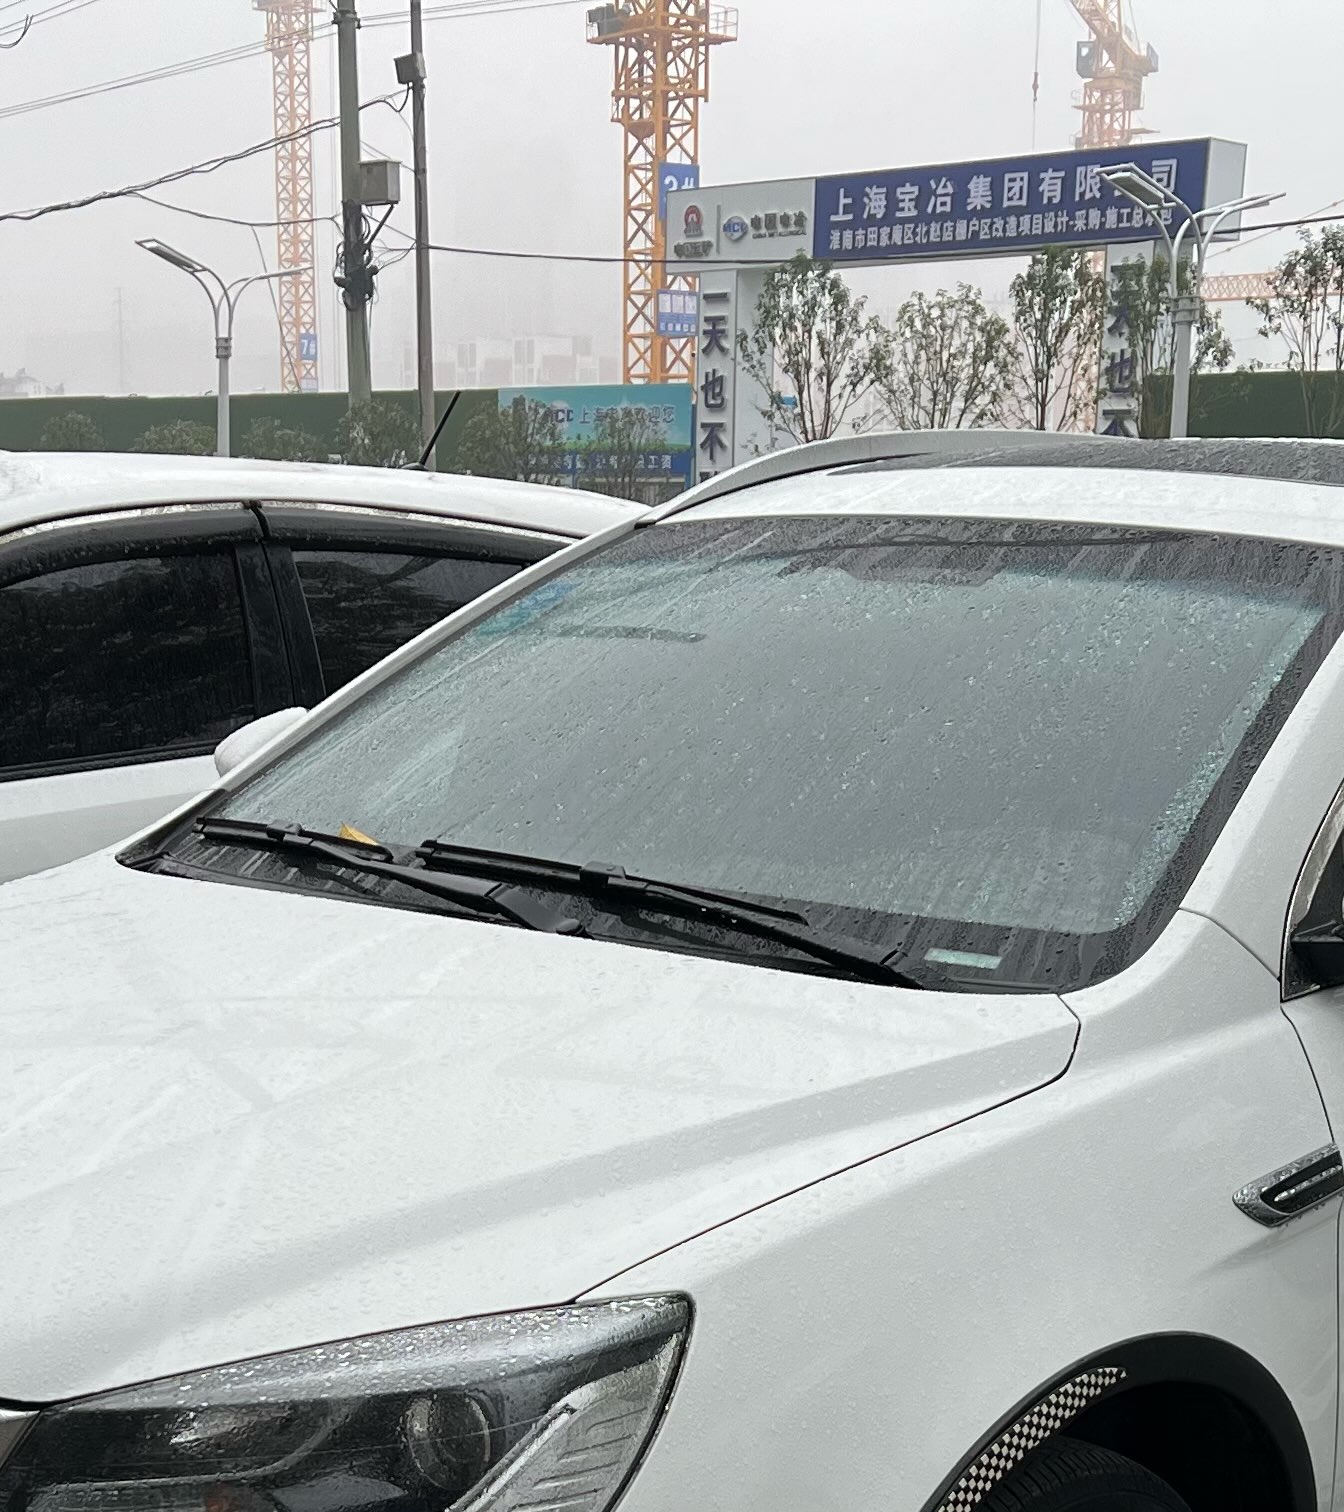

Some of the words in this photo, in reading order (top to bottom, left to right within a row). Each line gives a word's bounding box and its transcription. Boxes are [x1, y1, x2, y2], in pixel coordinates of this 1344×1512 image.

[829, 158, 1178, 222] 上海宝冶集团有限司
